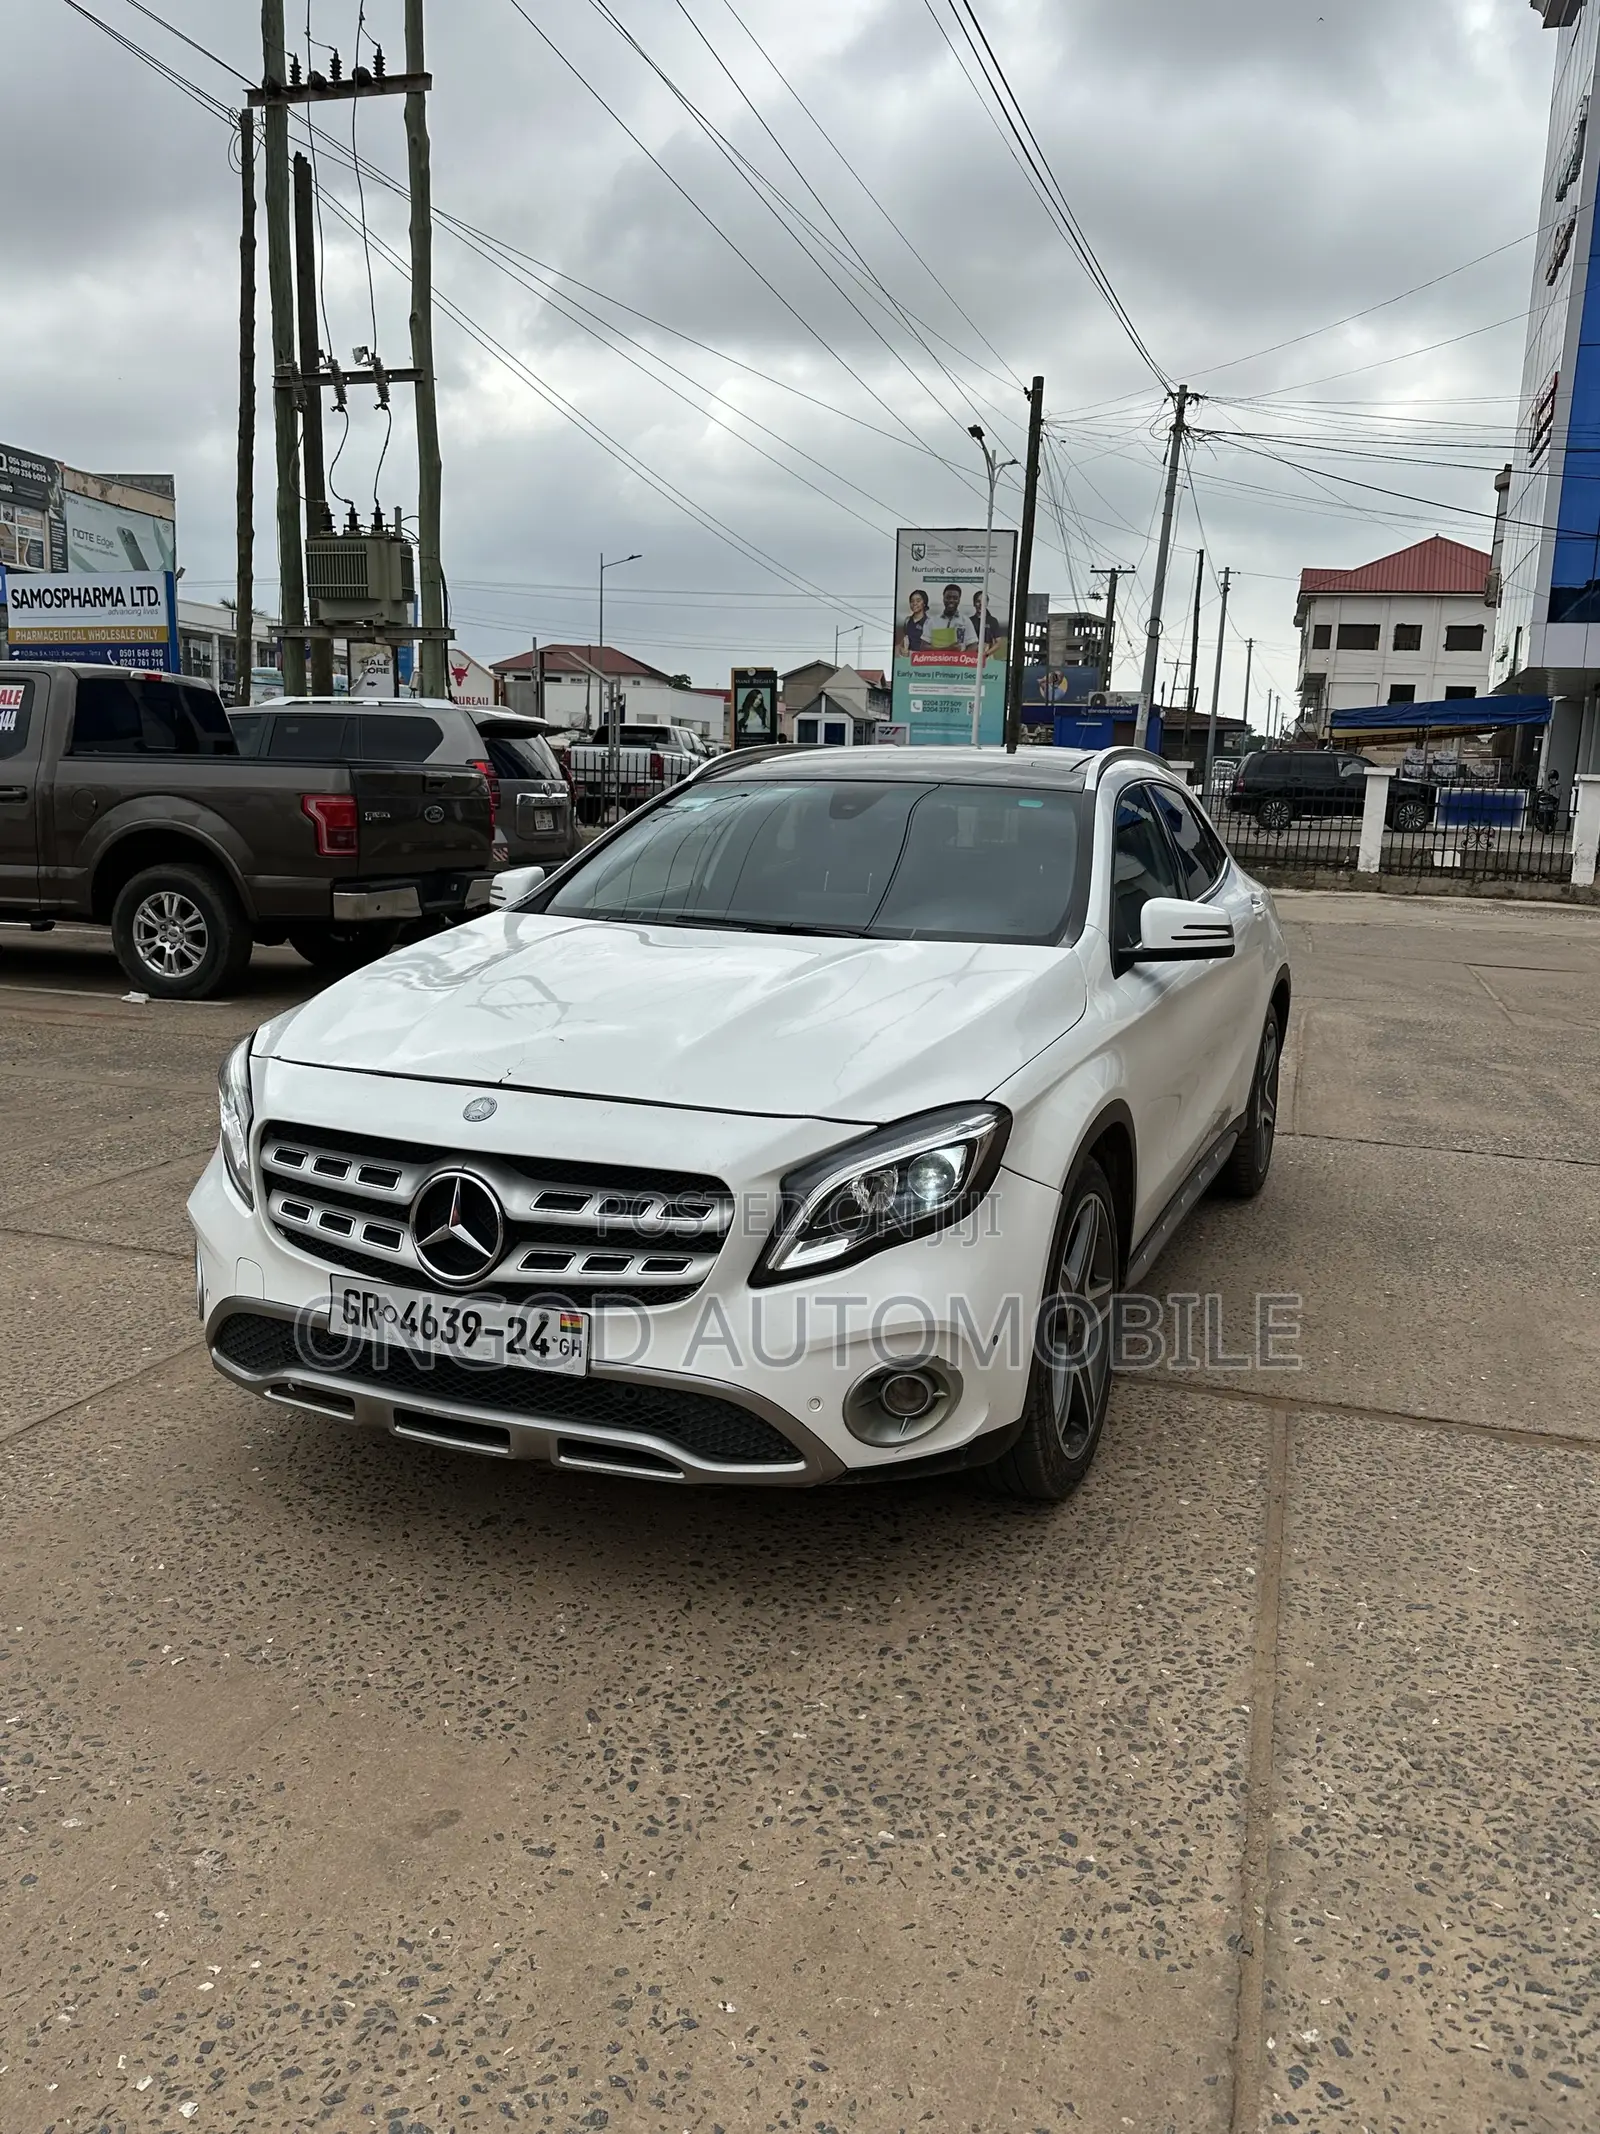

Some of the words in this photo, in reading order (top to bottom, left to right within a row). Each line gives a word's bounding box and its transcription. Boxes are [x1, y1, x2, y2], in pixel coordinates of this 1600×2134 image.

[96, 534, 115, 549] Edge
[911, 565, 945, 574] Nurturing
[11, 587, 126, 609] SAMOSPHARMA
[130, 586, 161, 607] LTD.
[107, 609, 142, 617] advancing
[15, 630, 87, 641] PHARMACEUTICAL
[88, 629, 135, 641] WHOLESALE
[137, 629, 158, 640] ONLY
[119, 649, 135, 657] 0501
[137, 649, 150, 657] 646
[151, 649, 164, 657] 490
[152, 659, 164, 667] 716
[913, 654, 959, 663] Admissions
[896, 670, 914, 679] Early
[935, 671, 961, 680] Primary
[964, 672, 998, 681] Secdary
[453, 696, 489, 706] BUREAU
[343, 1288, 380, 1330] GR
[400, 1300, 550, 1359] 4639-24
[559, 1338, 583, 1358] GH
